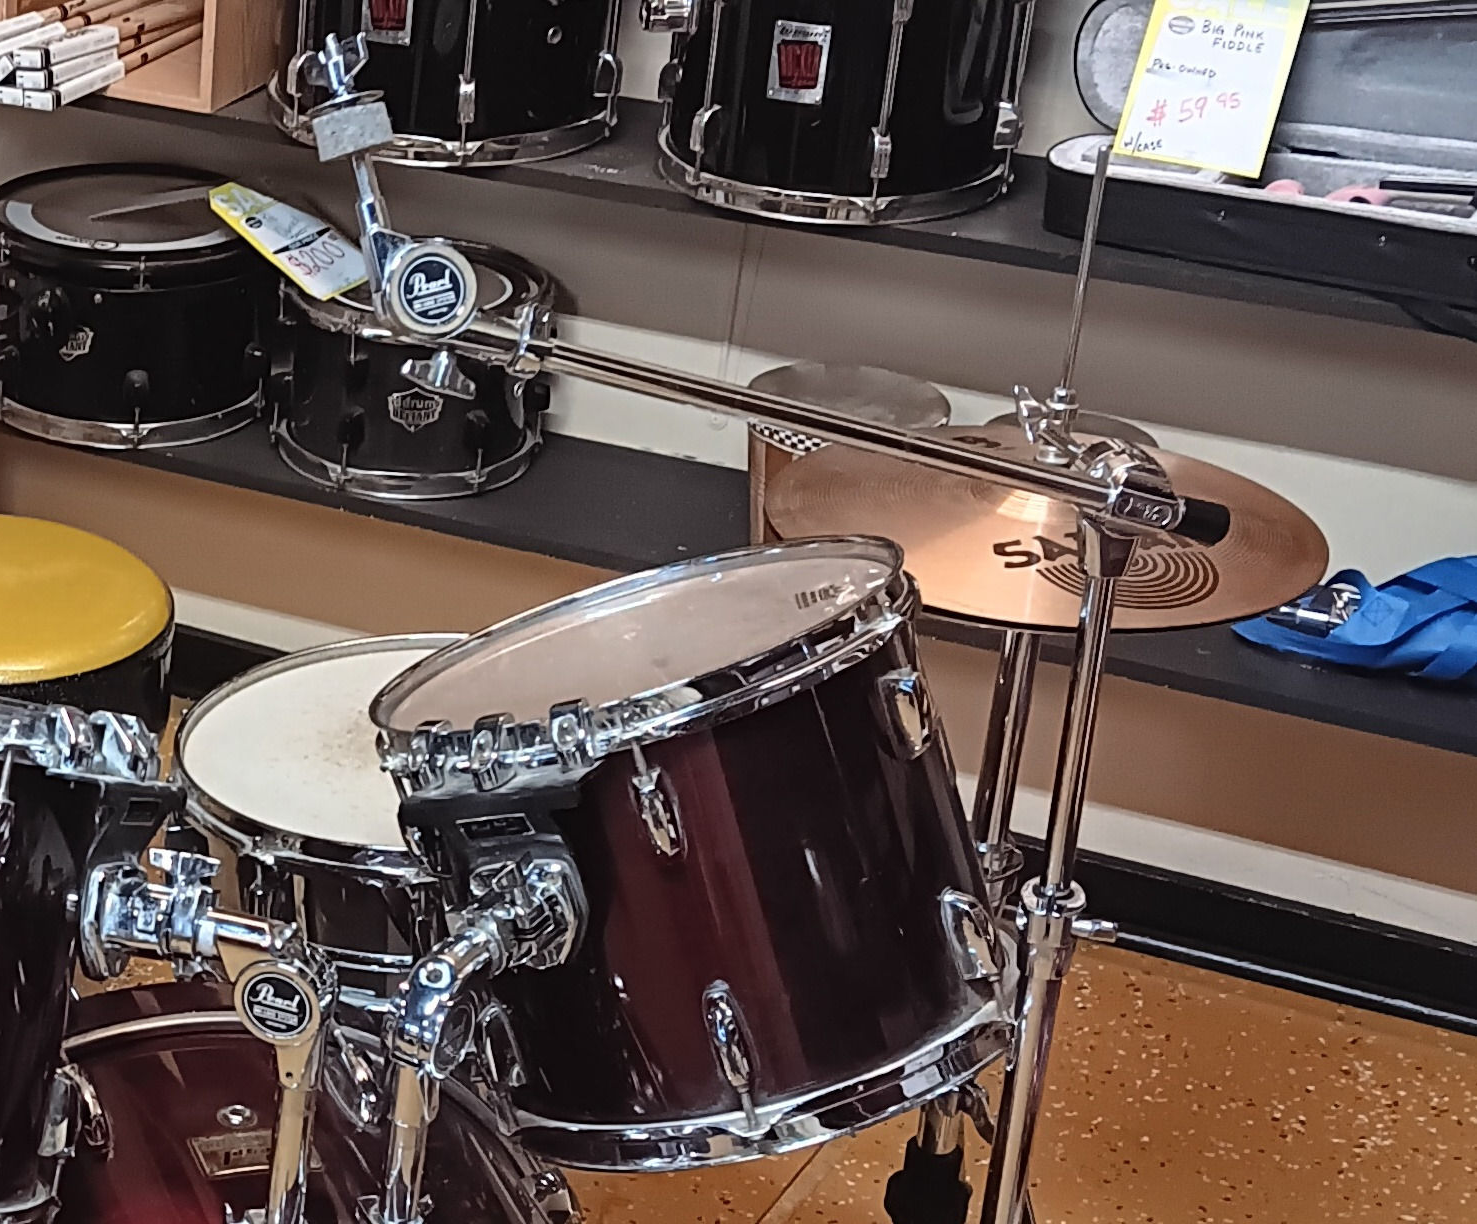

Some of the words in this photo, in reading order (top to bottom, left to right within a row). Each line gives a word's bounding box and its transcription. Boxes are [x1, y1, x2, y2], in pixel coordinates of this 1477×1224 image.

[1233, 24, 1264, 40] PINK
[1212, 37, 1265, 53] FIDDLE
[406, 268, 452, 299] Pearl
[249, 983, 300, 1012] Pearl
